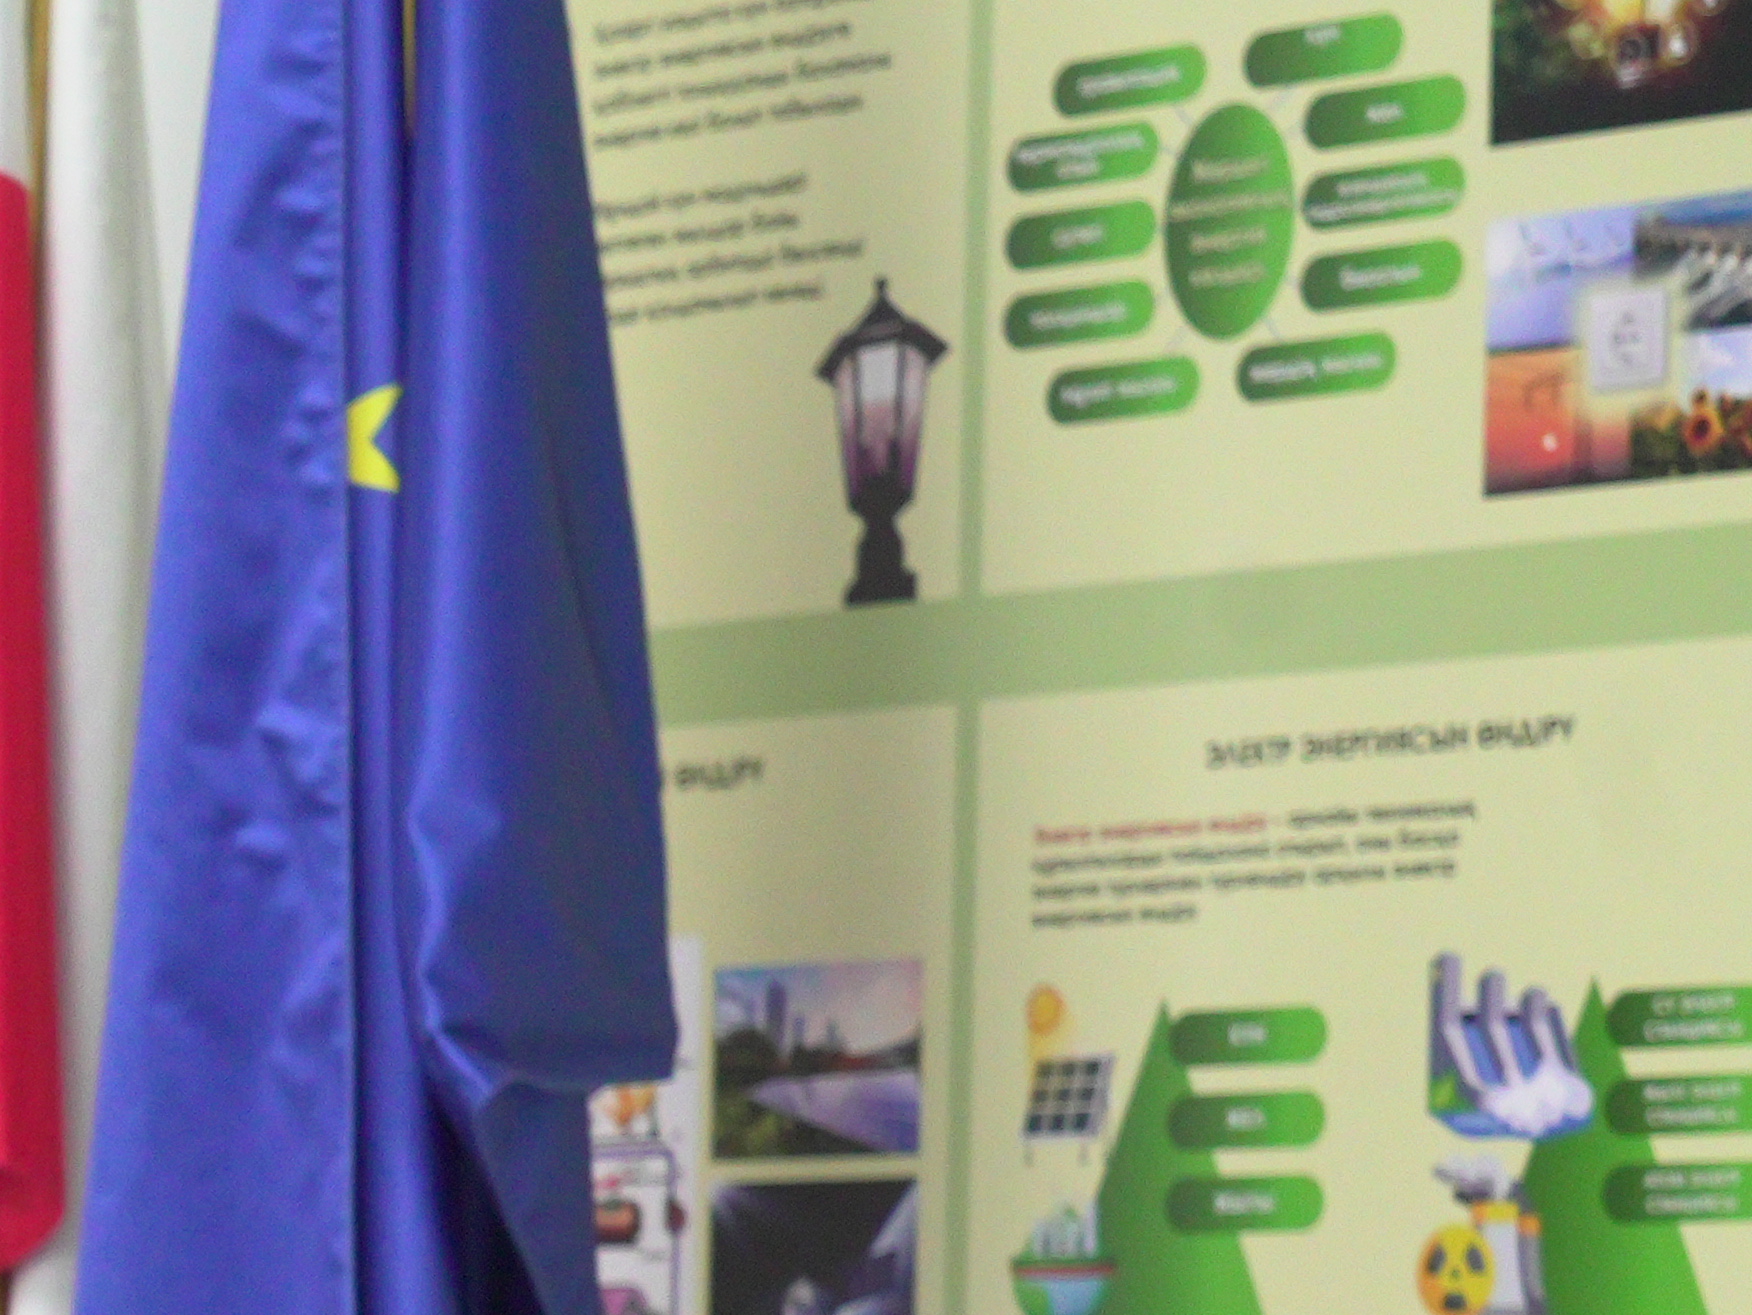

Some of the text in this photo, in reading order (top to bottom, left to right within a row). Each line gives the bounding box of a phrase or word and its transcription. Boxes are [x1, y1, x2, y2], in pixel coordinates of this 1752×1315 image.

[1204, 714, 1576, 769] ЭЛЕКТР ЭНЕРГИЯСЫН ӨНДІРУ
